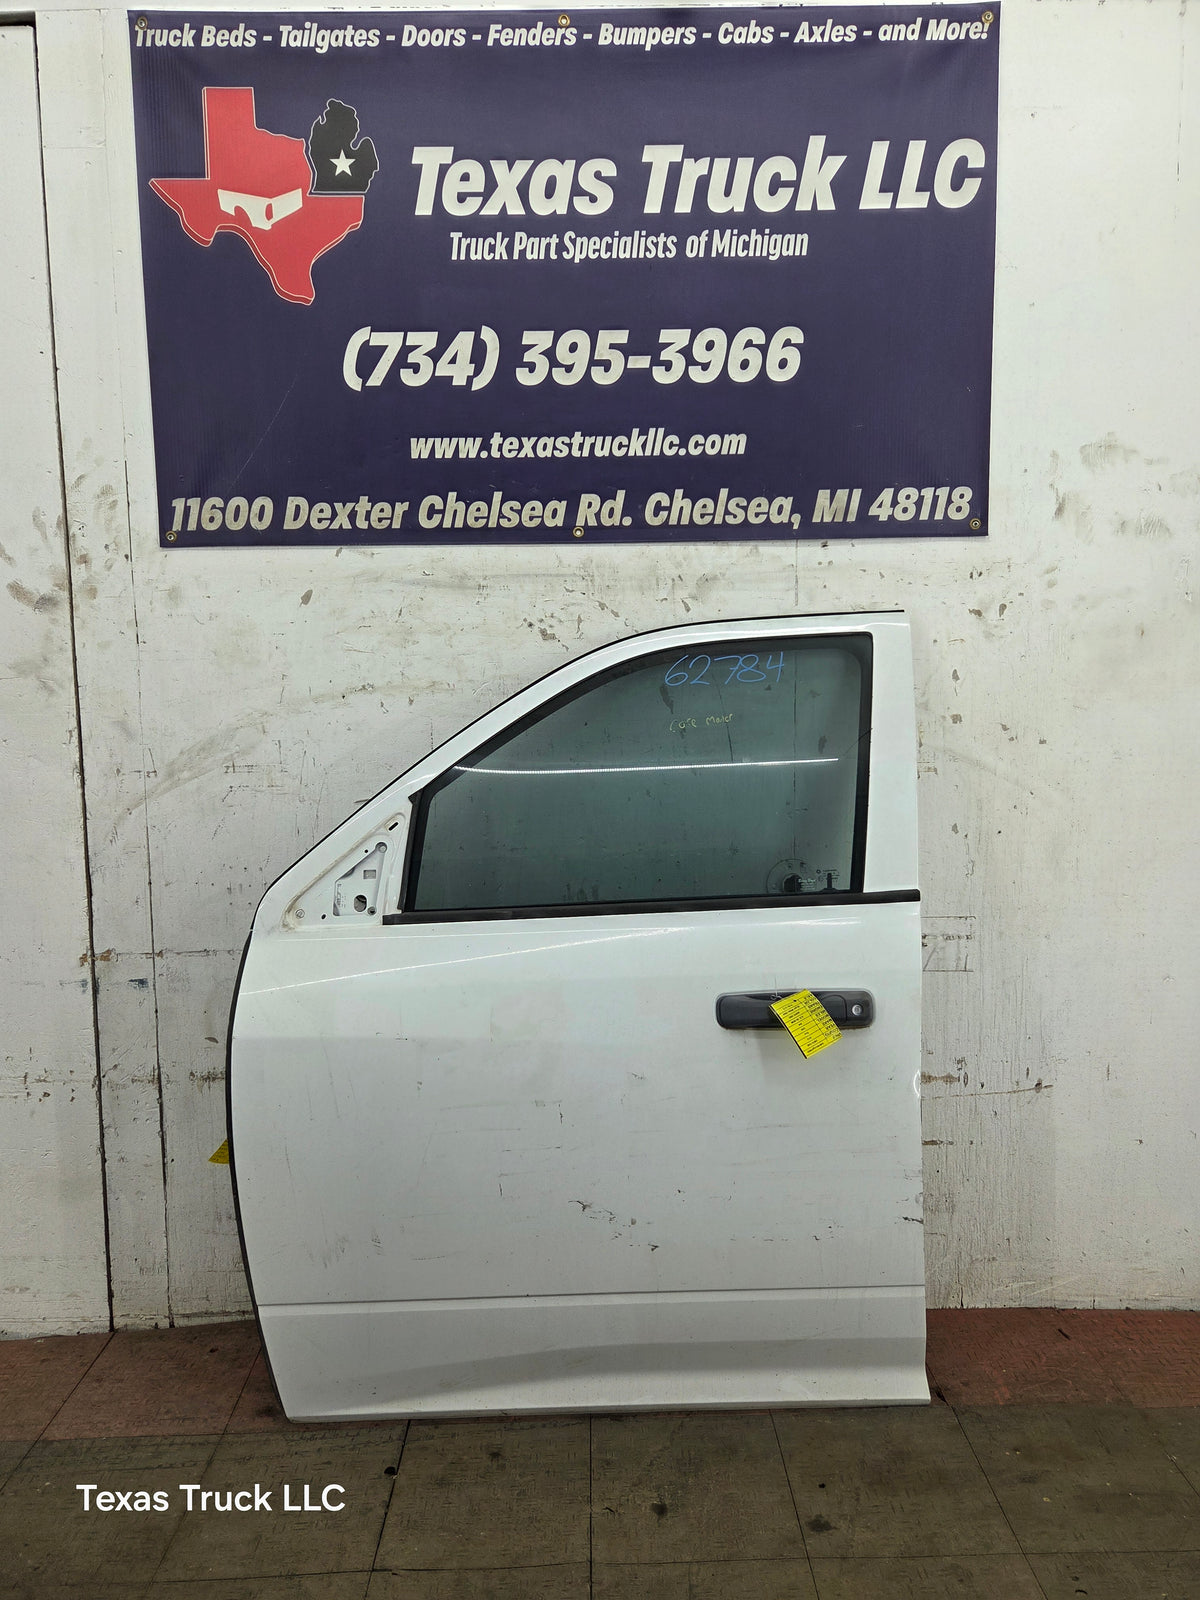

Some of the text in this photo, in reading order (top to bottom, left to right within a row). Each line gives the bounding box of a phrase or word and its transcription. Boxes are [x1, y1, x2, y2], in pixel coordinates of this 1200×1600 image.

[135, 22, 196, 47] Truck
[201, 22, 258, 48] Beds
[279, 22, 381, 53] Tailgates
[401, 24, 467, 47] Doors
[486, 21, 578, 47] Fenders
[597, 22, 697, 52] Bumpers
[718, 19, 775, 45] Cabs
[793, 18, 858, 44] Axles
[878, 17, 922, 42] and
[926, 17, 990, 41] More!
[411, 134, 986, 217] Texas Truck LLC
[450, 227, 809, 264] Truck Part Specialists of Michigan
[342, 325, 805, 392] (734) 395-3966
[410, 427, 747, 459] www.texastruckllc.com
[172, 486, 973, 533] 11600 Dexter Chelsea Rd. Chelsea, MI 48118
[664, 651, 785, 687] 62784
